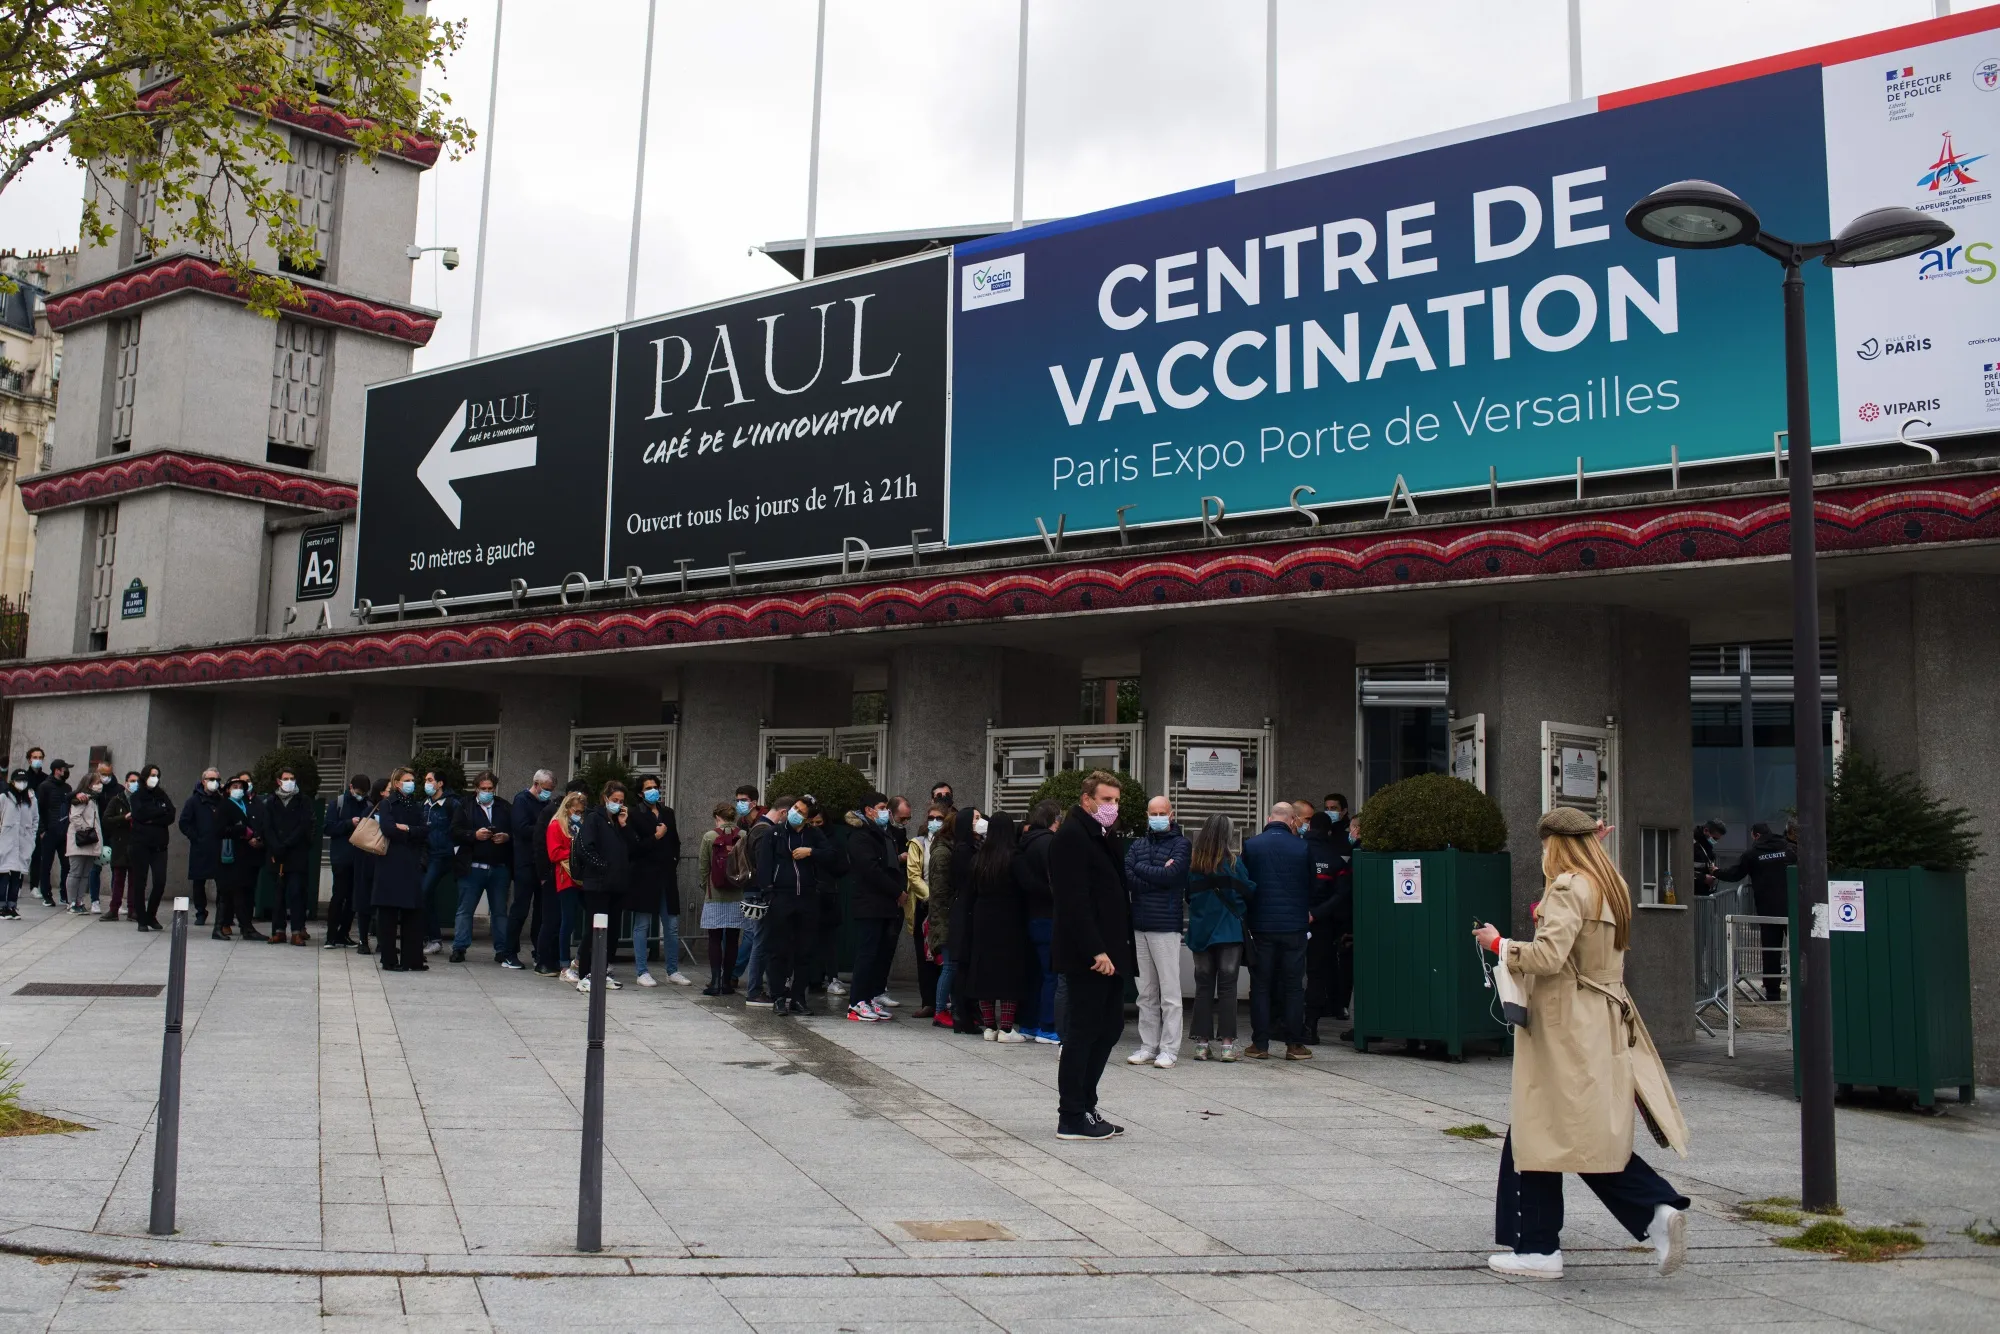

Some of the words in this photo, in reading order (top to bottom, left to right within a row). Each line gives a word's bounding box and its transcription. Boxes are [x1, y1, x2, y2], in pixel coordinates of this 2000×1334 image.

[1886, 72, 1952, 92] PRÉFECTURE
[1887, 93, 1901, 102] DE
[1904, 84, 1942, 99] POLICE
[1915, 193, 1992, 212] SAPEURS-POMPIERS
[1938, 187, 1966, 196] BRIGADE
[1097, 201, 1439, 331] CENTRE
[1472, 165, 1610, 264] DE
[643, 293, 903, 421] PAUL
[1048, 255, 1679, 427] VACCINATION
[1885, 338, 1932, 355] PARIS
[1984, 381, 1995, 389] DE
[469, 393, 536, 430] PAUL
[1883, 398, 1941, 416] VIPARIS
[483, 432, 491, 440] DE
[697, 430, 724, 456] DE
[731, 401, 903, 447] L'INNOVATION
[1053, 448, 1139, 490] Paris
[1152, 440, 1245, 481] Expo
[1260, 420, 1371, 463] Porte
[1385, 405, 1440, 446] de
[1452, 375, 1680, 436] Versailles
[626, 507, 682, 535] Ouvert
[687, 505, 723, 526] tous
[728, 498, 750, 522] les
[754, 495, 800, 525] jours
[805, 487, 827, 512] de
[833, 482, 857, 509] 7h
[863, 480, 874, 504] à
[879, 473, 918, 502] 21h
[307, 539, 320, 548] porte
[409, 552, 425, 571] 50
[428, 547, 472, 569] mètres
[476, 544, 483, 563] à
[487, 538, 536, 566] gauche
[283, 588, 448, 633] PARIS
[511, 551, 747, 609] PORTE
[842, 528, 933, 574] DE
[303, 551, 334, 587] A2
